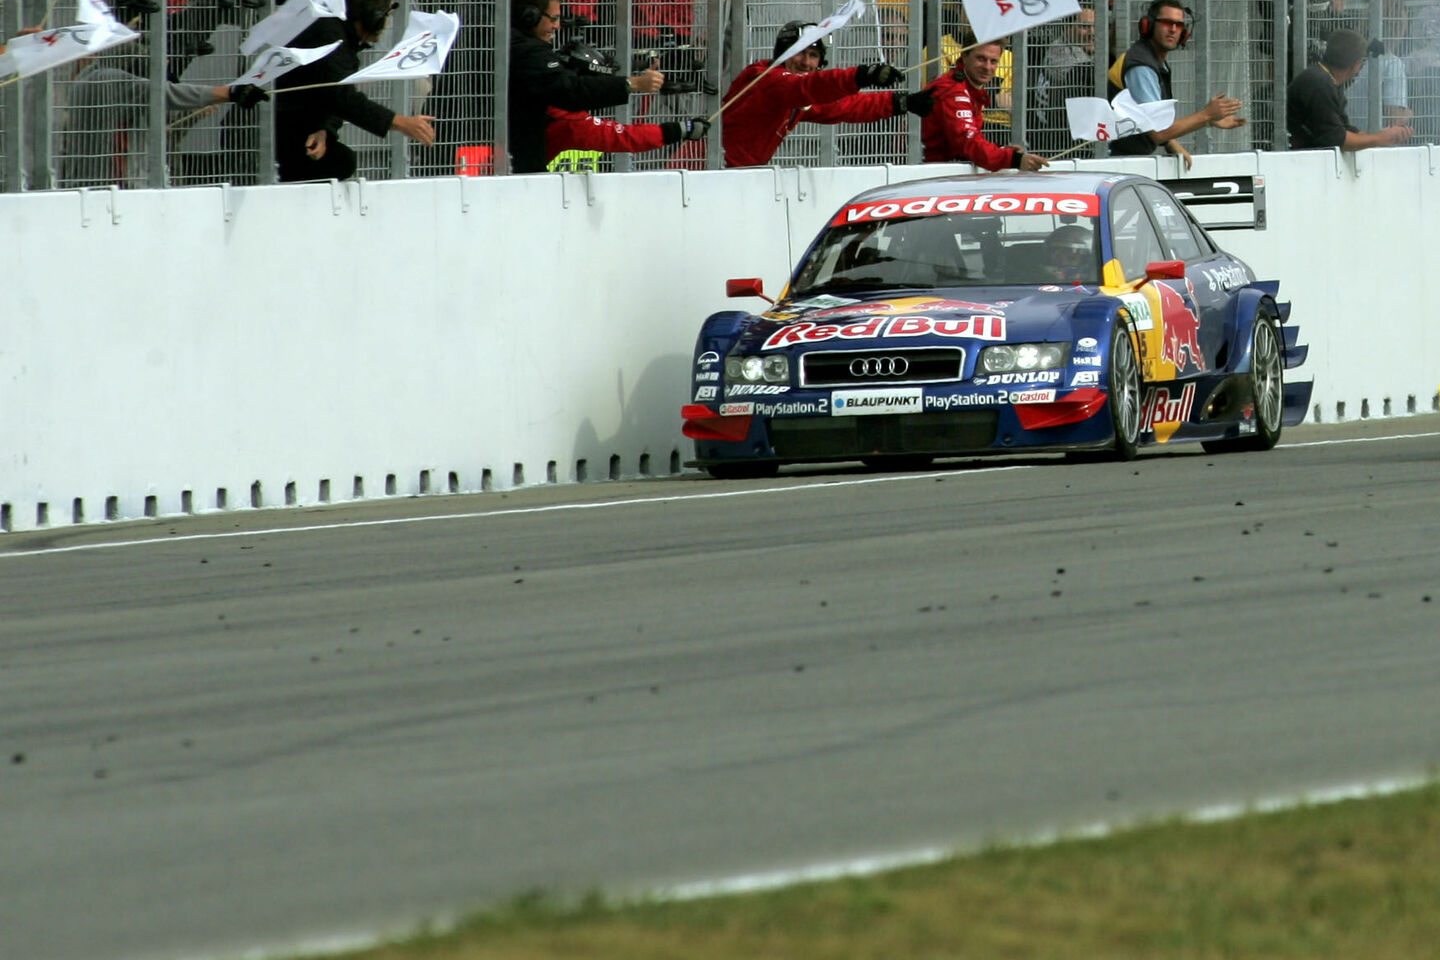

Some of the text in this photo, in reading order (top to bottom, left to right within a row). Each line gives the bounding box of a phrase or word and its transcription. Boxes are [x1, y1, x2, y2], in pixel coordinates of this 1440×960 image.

[846, 194, 1089, 222] vodafone
[763, 315, 1006, 350] Red Bull
[986, 372, 1060, 385] DUNLOP
[1071, 370, 1101, 386] ABT
[728, 384, 791, 397] DUNLOP
[1019, 391, 1050, 402] Castrol
[846, 396, 920, 408] BLAUPUNKT
[1152, 382, 1197, 423] Bull
